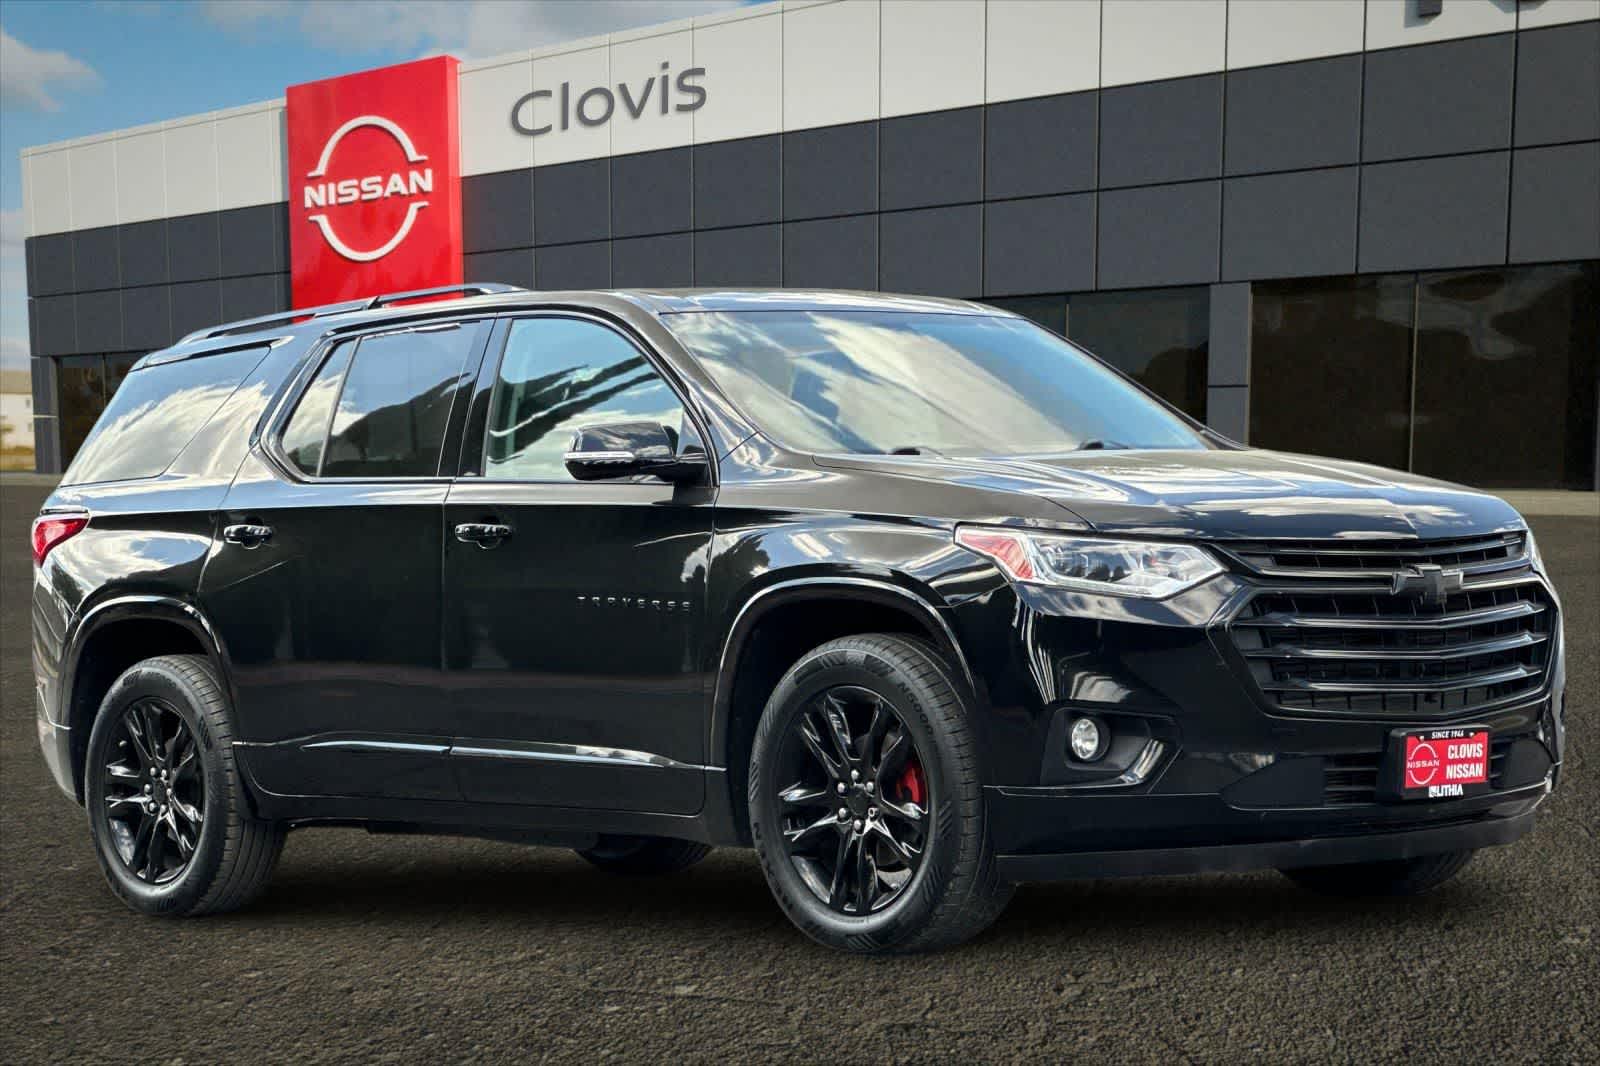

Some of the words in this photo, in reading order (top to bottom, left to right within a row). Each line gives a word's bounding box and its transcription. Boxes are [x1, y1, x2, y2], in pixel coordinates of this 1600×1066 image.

[510, 61, 708, 137] Clovis
[304, 167, 434, 209] NISSAN
[1431, 731, 1450, 740] SINCE
[1448, 743, 1483, 759] CLOVIS
[1407, 759, 1440, 769] NISSAN
[1446, 763, 1483, 780] NISSAN
